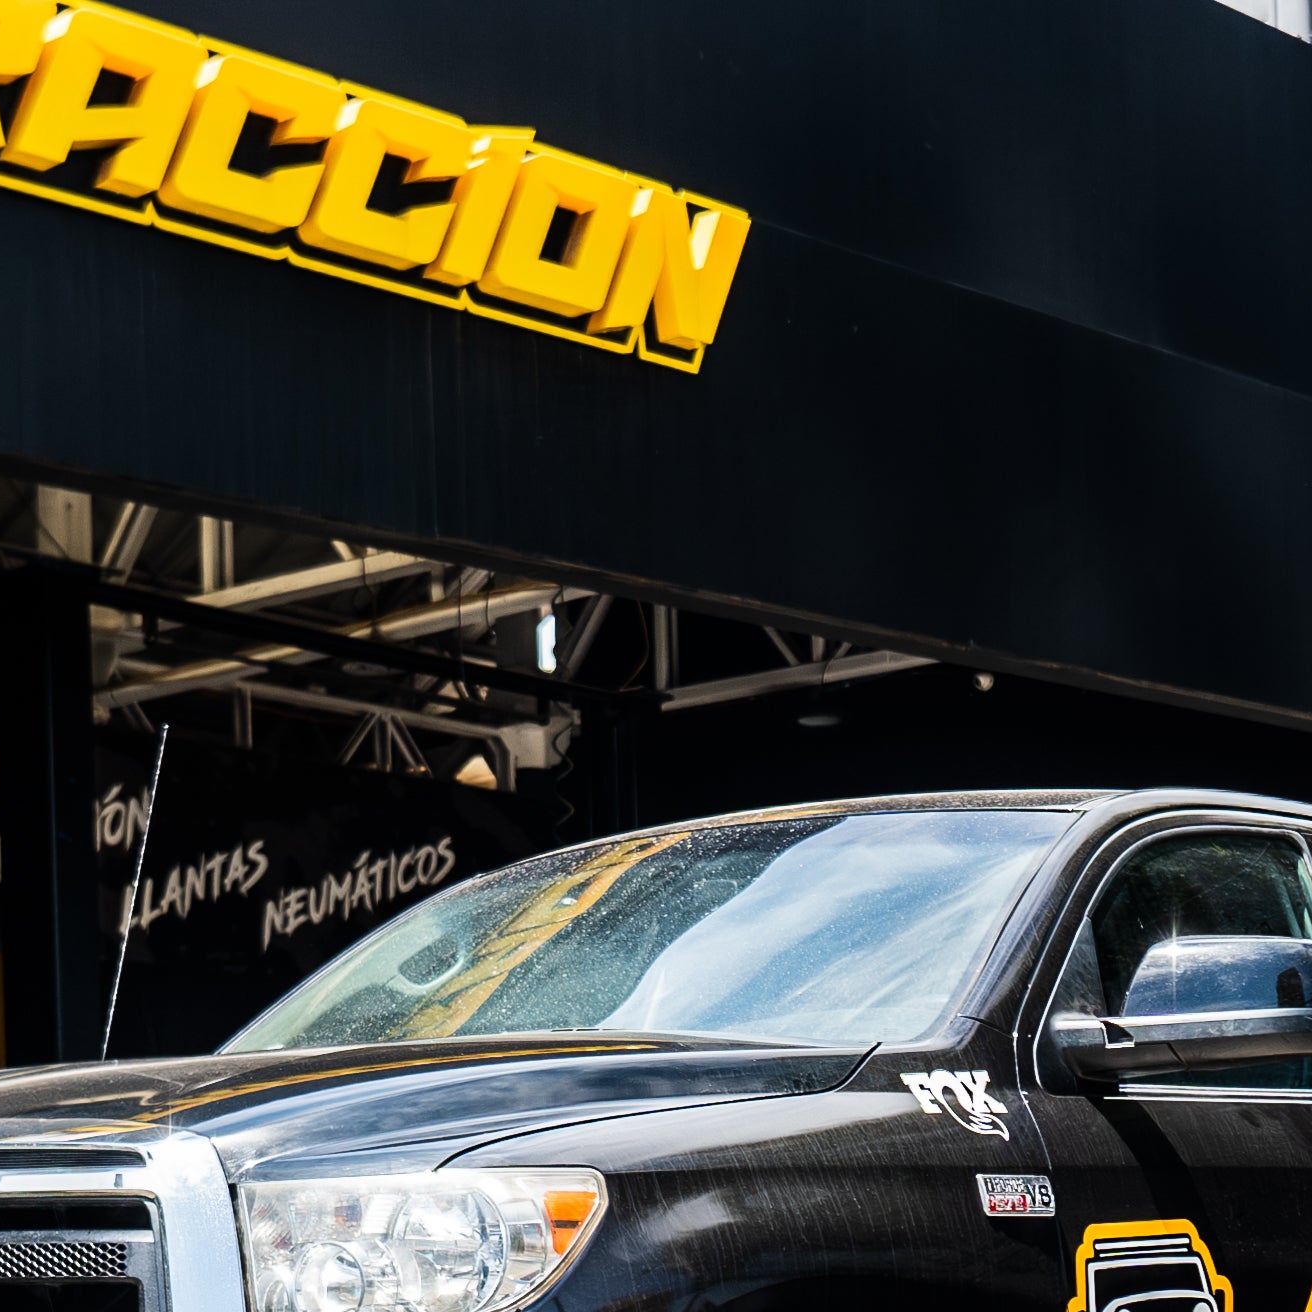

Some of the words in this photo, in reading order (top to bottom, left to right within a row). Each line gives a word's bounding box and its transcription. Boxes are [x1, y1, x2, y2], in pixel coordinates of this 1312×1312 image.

[119, 840, 268, 936] LLANTAS
[262, 836, 456, 954] NEUMÁTICOS
[899, 1069, 1010, 1138] FOX
